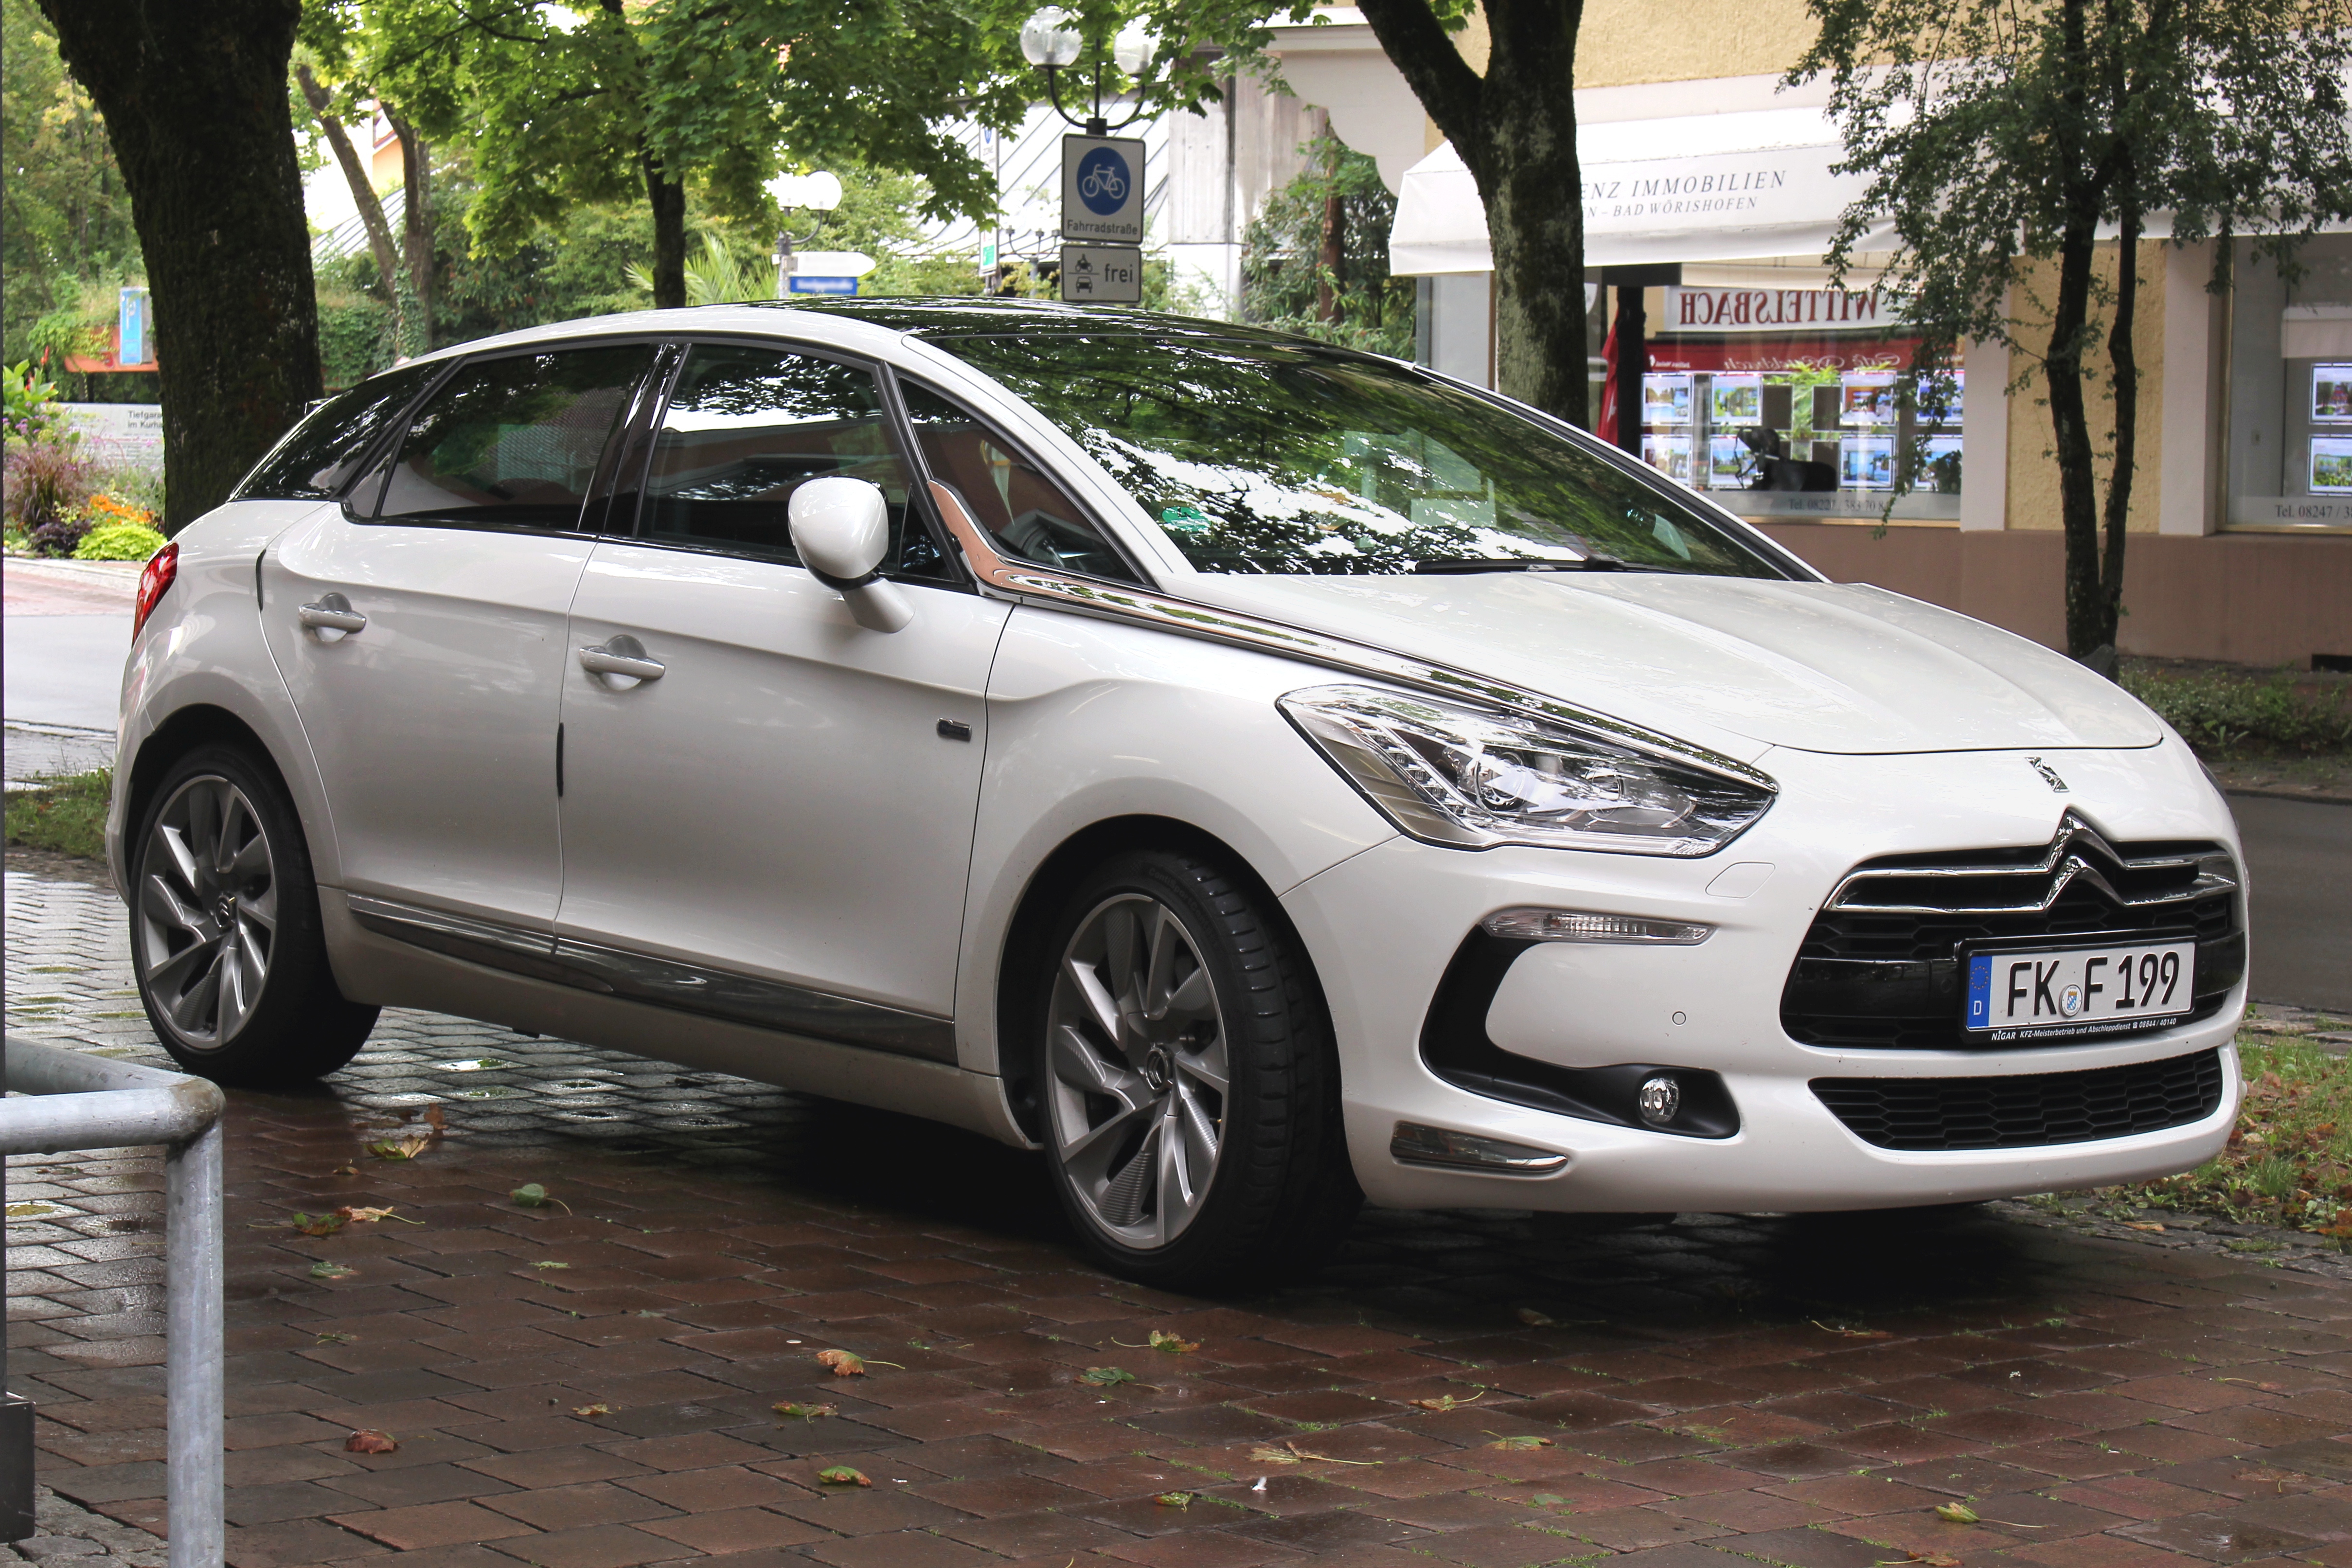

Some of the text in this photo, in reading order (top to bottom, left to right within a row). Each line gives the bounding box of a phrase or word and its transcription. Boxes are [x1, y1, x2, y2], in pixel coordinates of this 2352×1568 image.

[1632, 170, 1787, 197] IMMOBILIEN
[1613, 203, 1644, 217] BAD
[1650, 196, 1758, 214] WÖRISHOFEN
[1067, 219, 1138, 235] Fahrradstraße
[1105, 264, 1134, 283] frei
[2275, 504, 2294, 518] Tel.
[2298, 505, 2333, 518] 08247
[2007, 950, 2180, 1017] FK F 199
[1973, 1000, 1982, 1016] D
[2020, 1027, 2075, 1038] KFZ-Meisterbetrieb
[2087, 1023, 2131, 1033] Abschleppdienst
[2139, 1020, 2156, 1029] 08844
[2159, 1017, 2176, 1026] 40140
